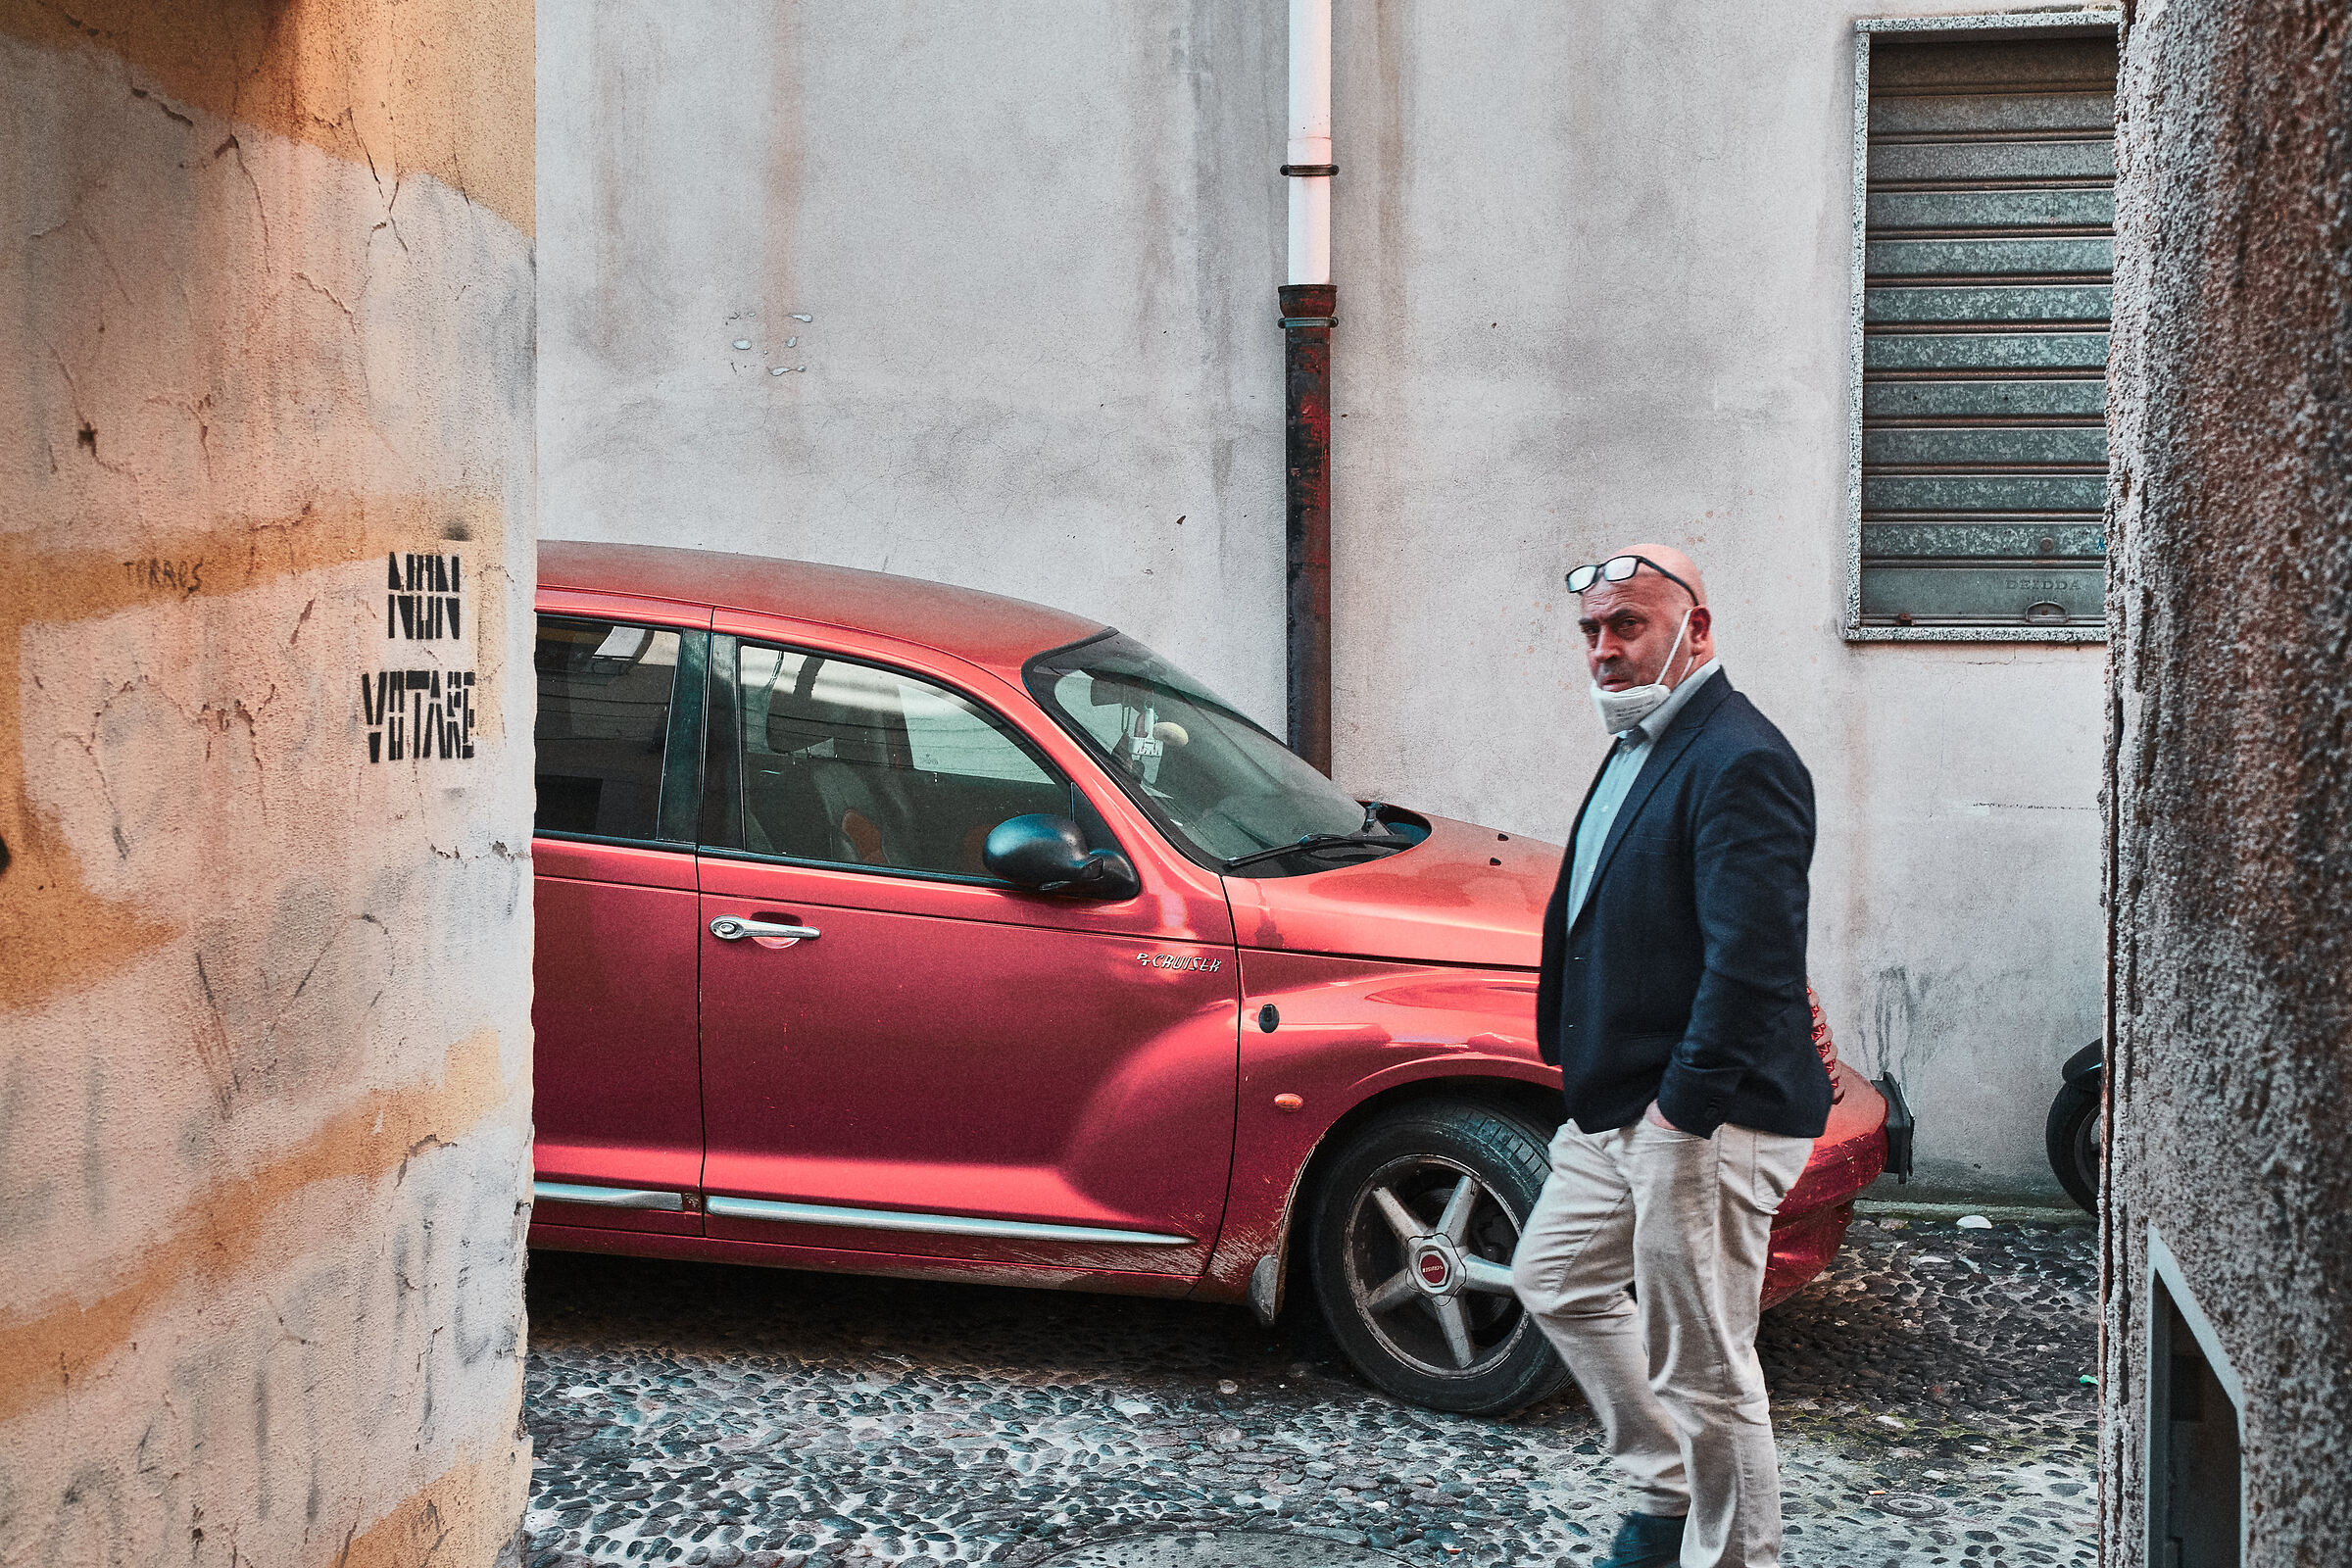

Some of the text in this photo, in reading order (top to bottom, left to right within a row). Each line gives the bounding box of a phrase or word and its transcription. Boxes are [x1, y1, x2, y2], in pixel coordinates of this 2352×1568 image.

[388, 552, 460, 640] NON
[362, 670, 475, 763] VOTARE
[1152, 954, 1222, 972] CRUISER
